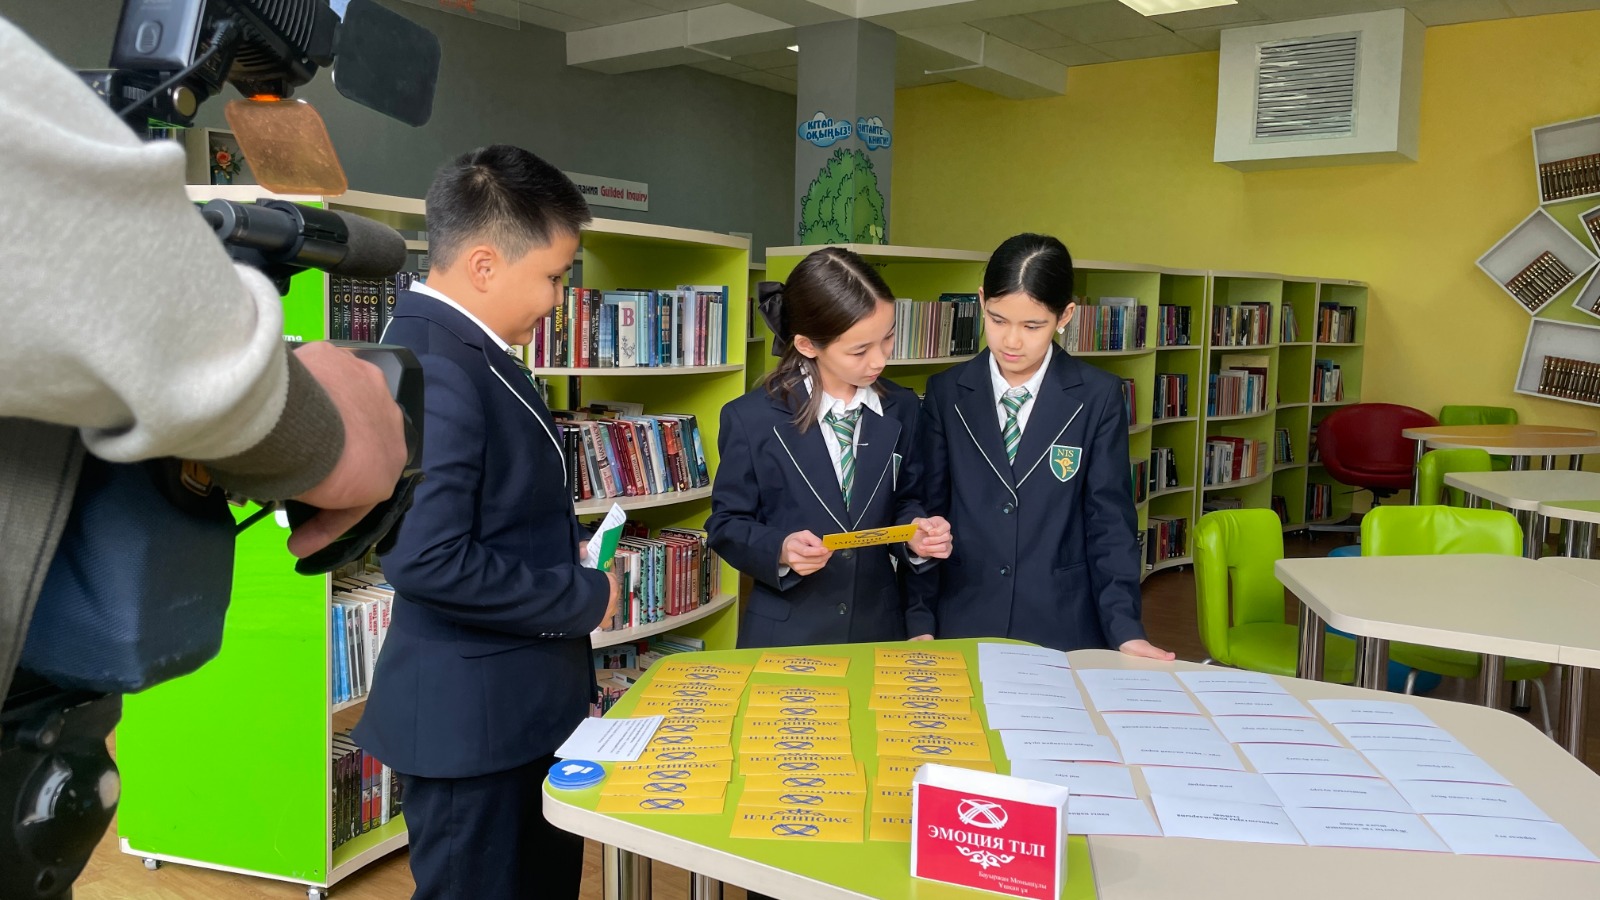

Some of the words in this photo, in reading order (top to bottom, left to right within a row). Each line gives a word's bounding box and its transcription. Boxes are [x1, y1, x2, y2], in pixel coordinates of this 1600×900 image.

[807, 118, 833, 130] КІТАП
[857, 122, 884, 136] ЧИТАЙТЕ
[806, 125, 851, 141] ОҚЫҢЫЗ!
[868, 135, 889, 145] КНИГИ!
[600, 185, 624, 199] Guilded
[626, 188, 648, 203] Inquiry
[1057, 448, 1074, 458] NIS
[928, 825, 1004, 850] ЭМОЦИЯ
[1008, 839, 1045, 858] ТІЛІ
